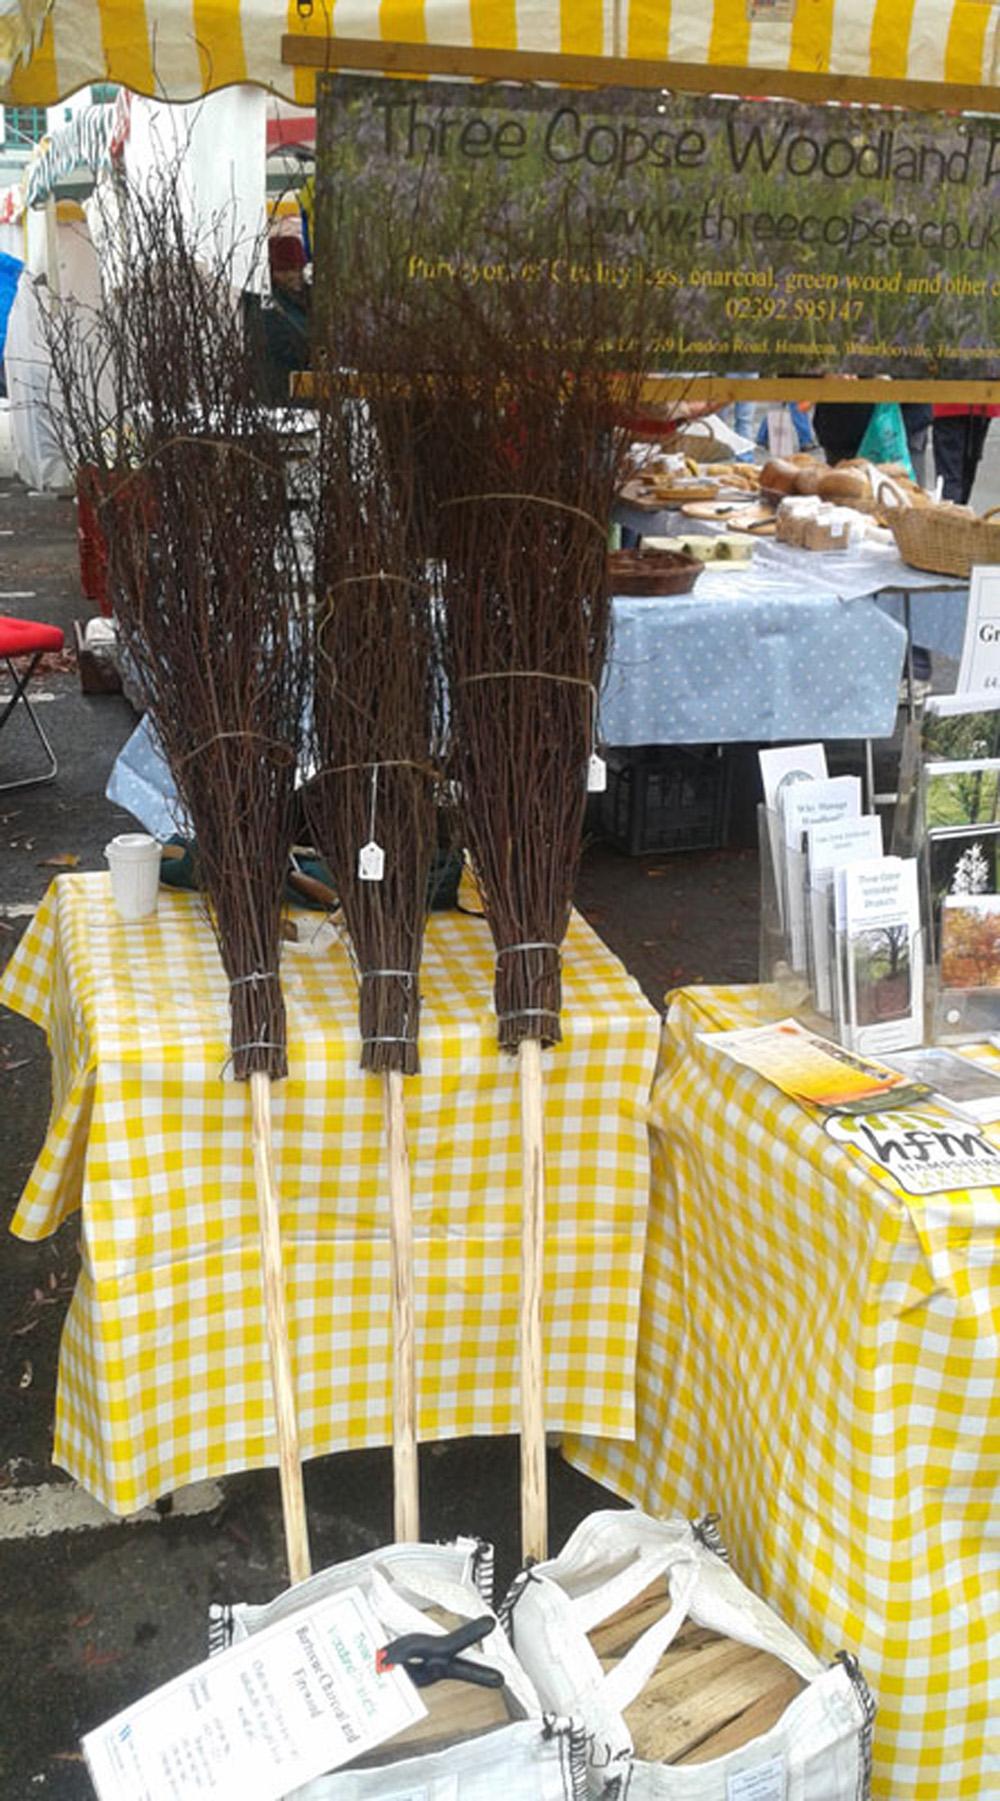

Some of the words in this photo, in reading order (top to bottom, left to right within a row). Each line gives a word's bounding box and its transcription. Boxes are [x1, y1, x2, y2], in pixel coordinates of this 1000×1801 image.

[374, 98, 527, 160] Three
[545, 107, 706, 180] Copse
[725, 116, 975, 185] Woodland
[785, 272, 839, 293] green
[845, 270, 901, 293] wood
[906, 272, 941, 295] and
[944, 275, 988, 297] other
